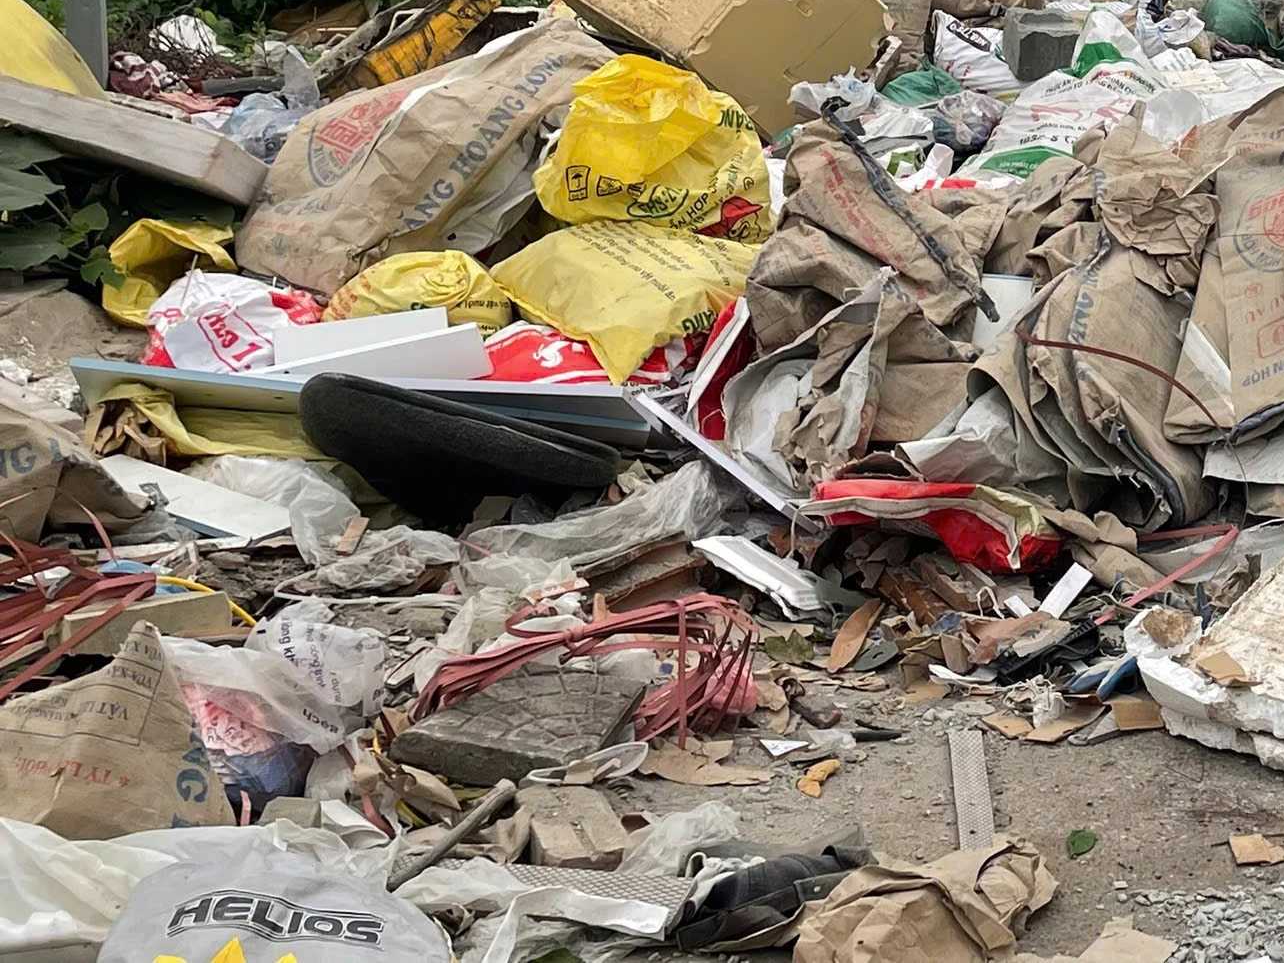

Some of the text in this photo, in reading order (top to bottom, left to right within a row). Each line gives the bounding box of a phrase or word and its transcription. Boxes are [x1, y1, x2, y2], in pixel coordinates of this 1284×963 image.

[450, 94, 526, 182] HOÀNG
[686, 191, 710, 219] HỢP
[166, 894, 385, 945] HELIOS
